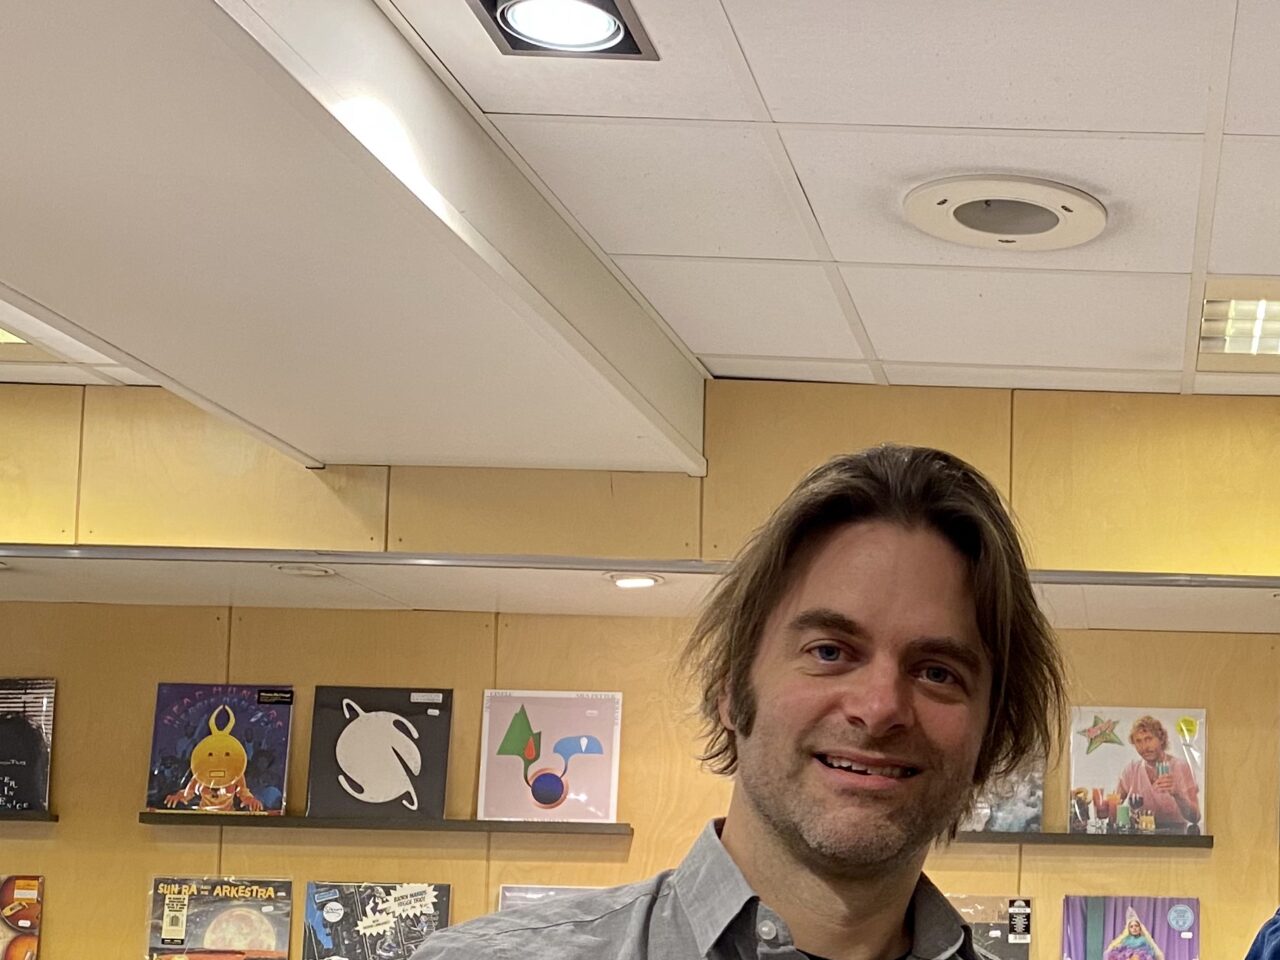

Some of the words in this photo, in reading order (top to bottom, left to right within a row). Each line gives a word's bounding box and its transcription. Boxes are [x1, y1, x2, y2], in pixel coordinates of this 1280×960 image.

[158, 883, 178, 895] SUN
[181, 884, 198, 896] RA
[213, 885, 275, 898] ARKESTRA
